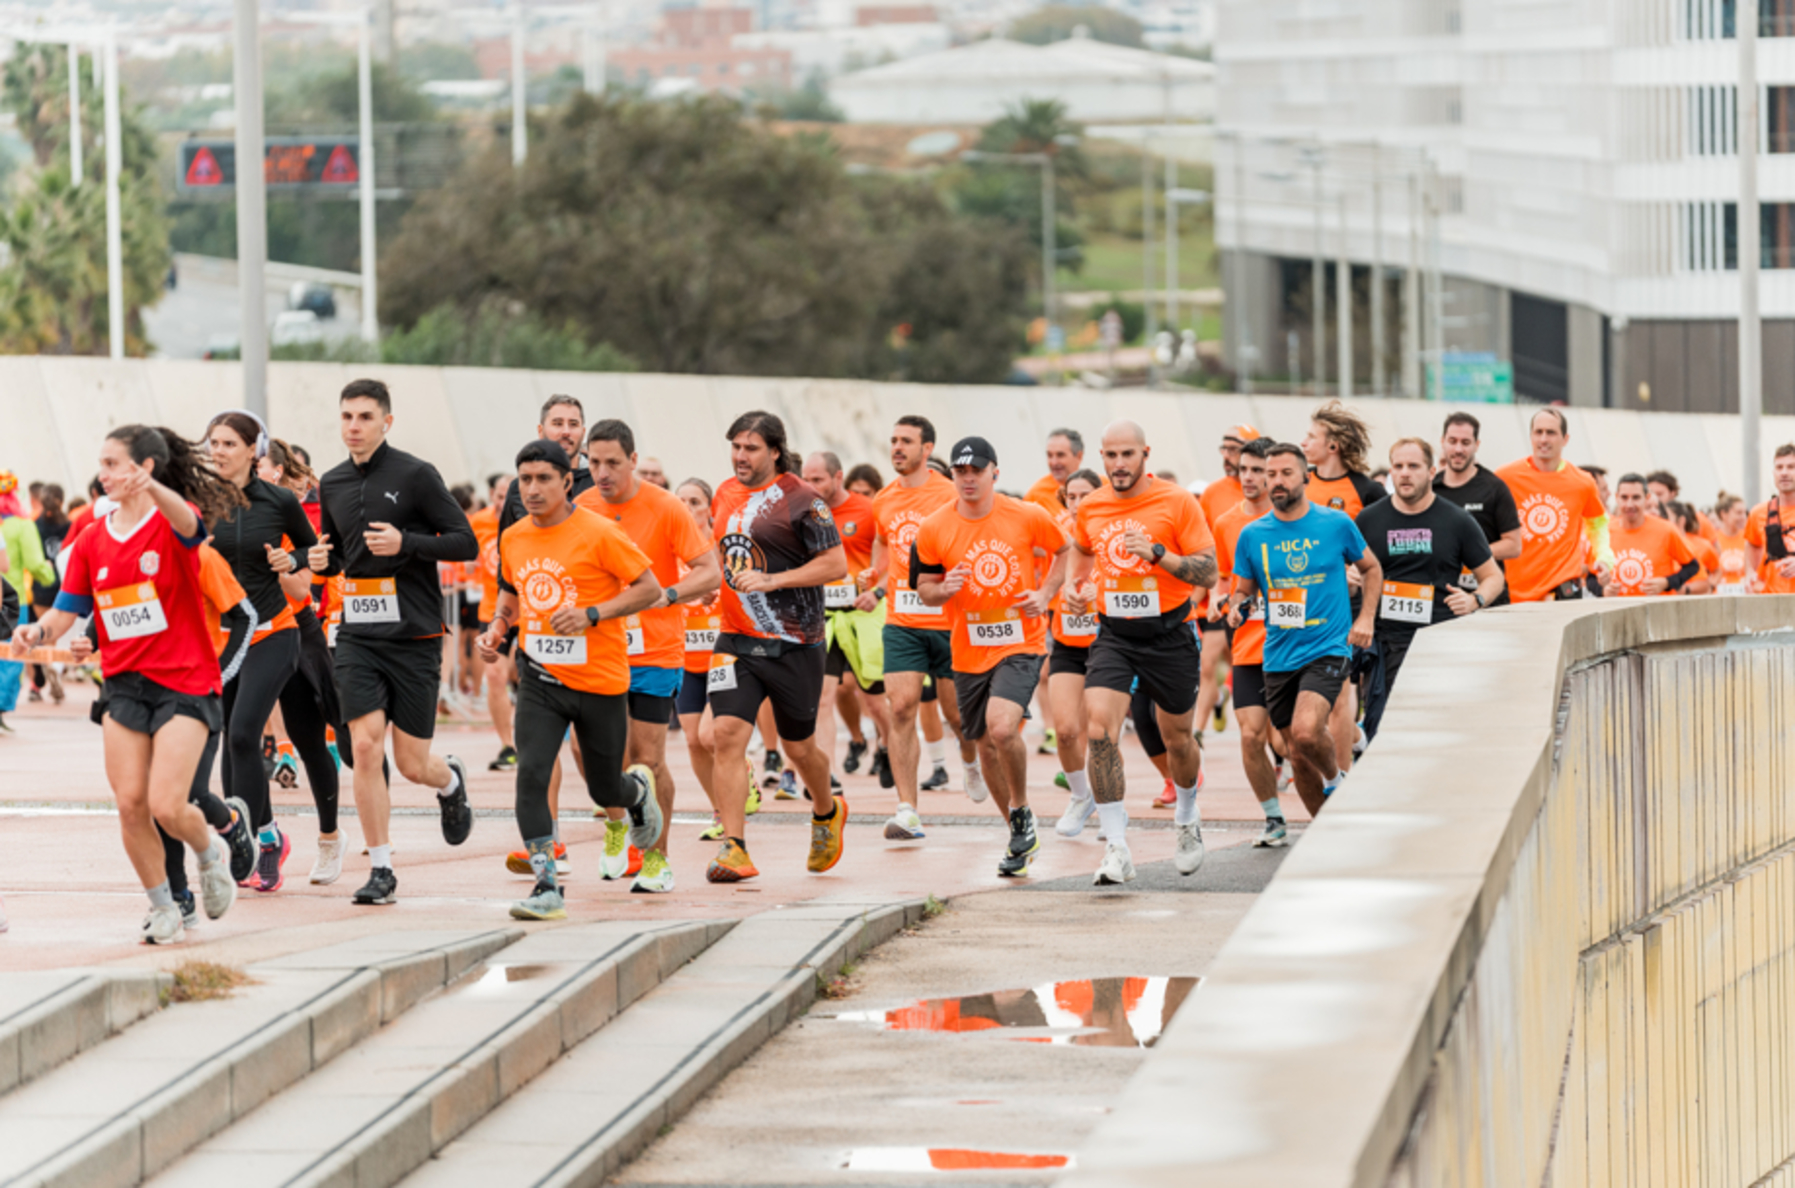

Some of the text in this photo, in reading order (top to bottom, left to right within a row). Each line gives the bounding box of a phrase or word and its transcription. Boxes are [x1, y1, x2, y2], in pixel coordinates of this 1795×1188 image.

[990, 539, 1013, 559] QUE
[541, 557, 567, 578] QUE
[825, 587, 848, 599] 445
[352, 598, 387, 613] 0591
[1114, 594, 1149, 609] 1590
[1389, 599, 1423, 614] 2115
[111, 606, 151, 628] 0054
[977, 623, 1013, 638] 0538
[535, 639, 575, 654] 1257
